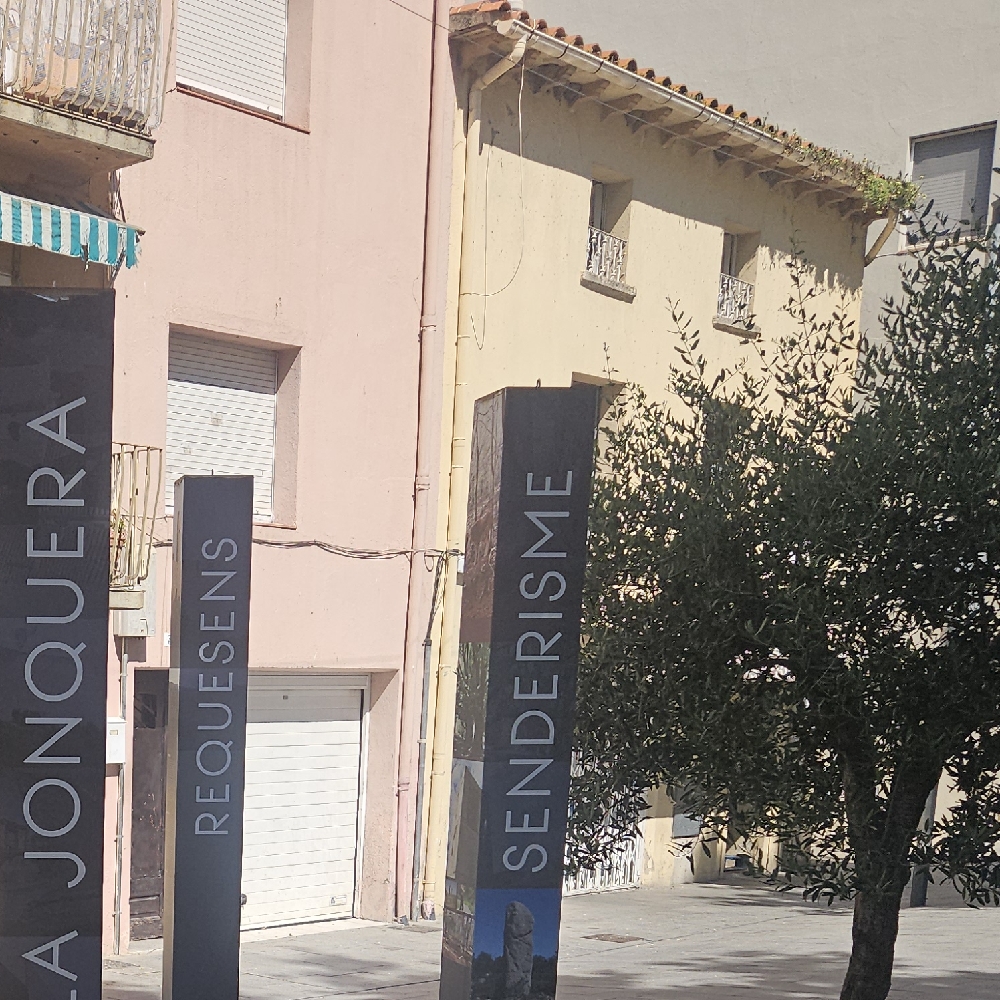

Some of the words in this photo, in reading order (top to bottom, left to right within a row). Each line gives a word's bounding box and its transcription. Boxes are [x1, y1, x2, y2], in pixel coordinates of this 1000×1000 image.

[22, 396, 87, 889] JONQUERA
[194, 537, 239, 836] REQUESENS
[502, 469, 574, 874] SENDERISME
